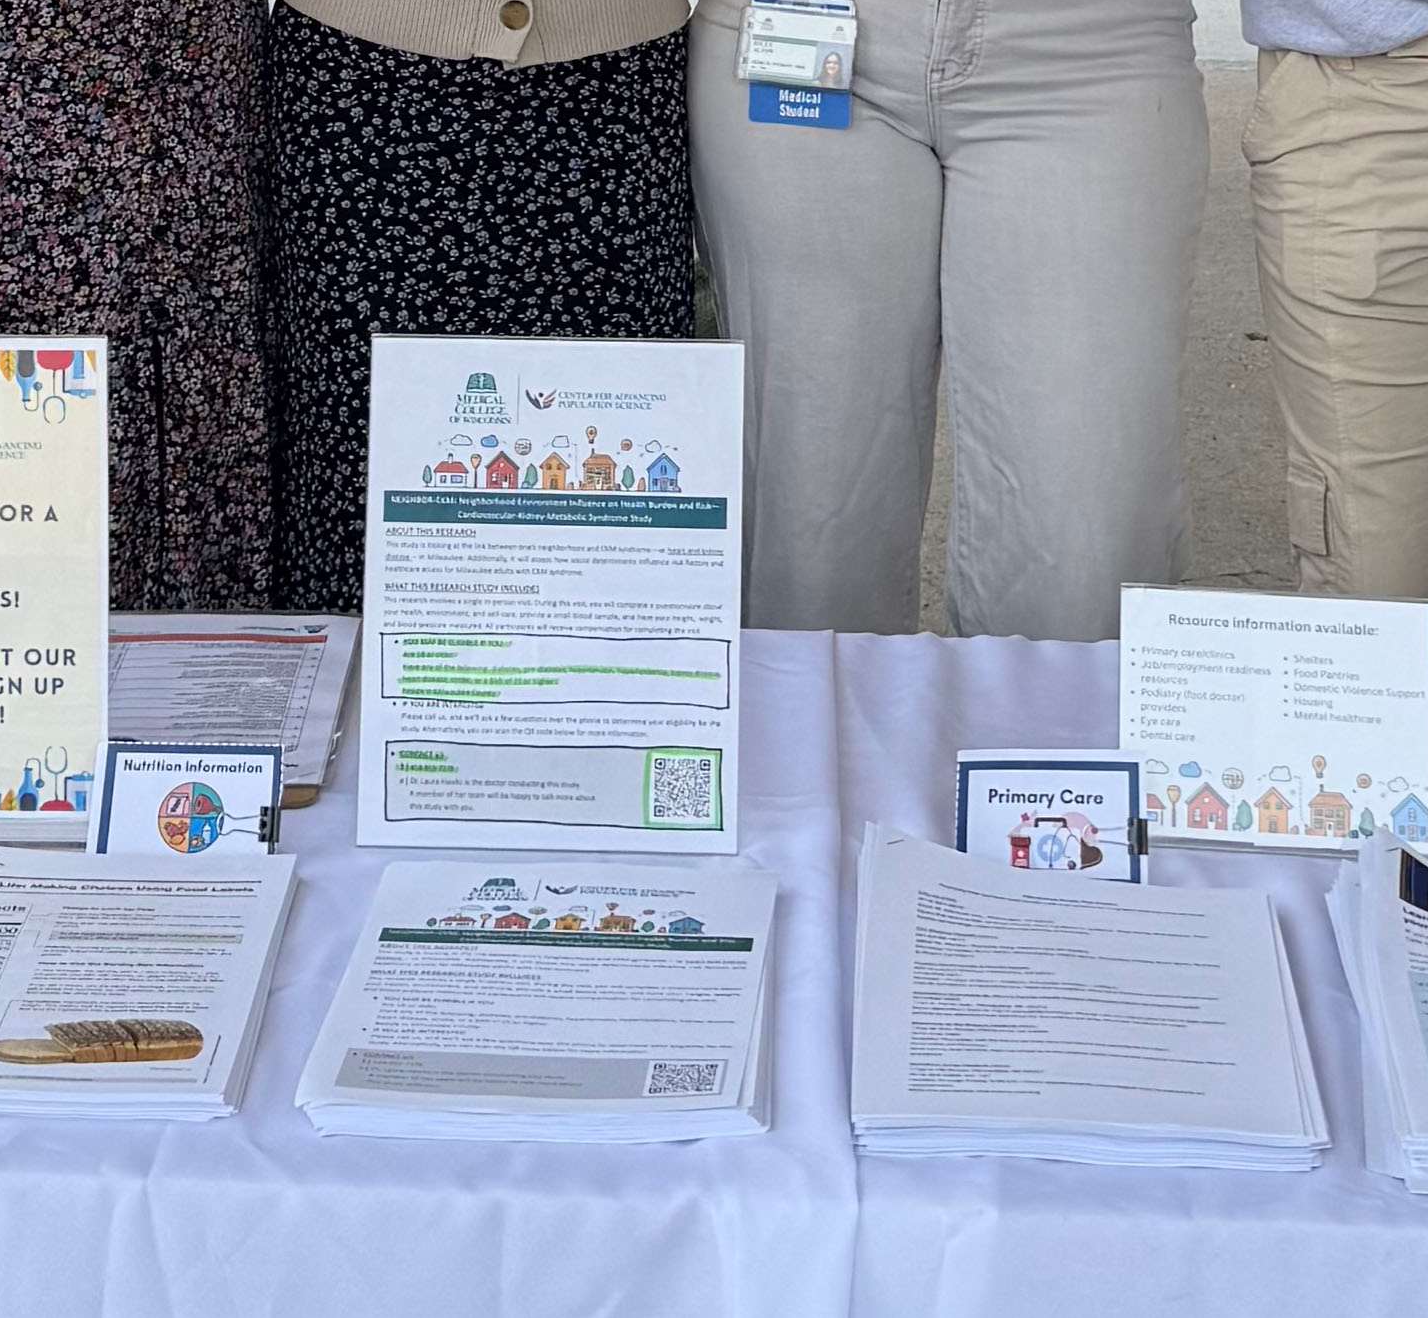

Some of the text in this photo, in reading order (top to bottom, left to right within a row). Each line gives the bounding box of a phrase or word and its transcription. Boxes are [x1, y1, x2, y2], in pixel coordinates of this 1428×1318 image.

[779, 90, 821, 103] Medical
[780, 105, 819, 118] Student
[44, 504, 59, 523] A
[1169, 614, 1378, 636] Resource information available:
[23, 648, 77, 667] OUR
[35, 676, 66, 695] UP
[124, 759, 262, 774] Nutrition Information
[988, 787, 1103, 808] Primary Care
